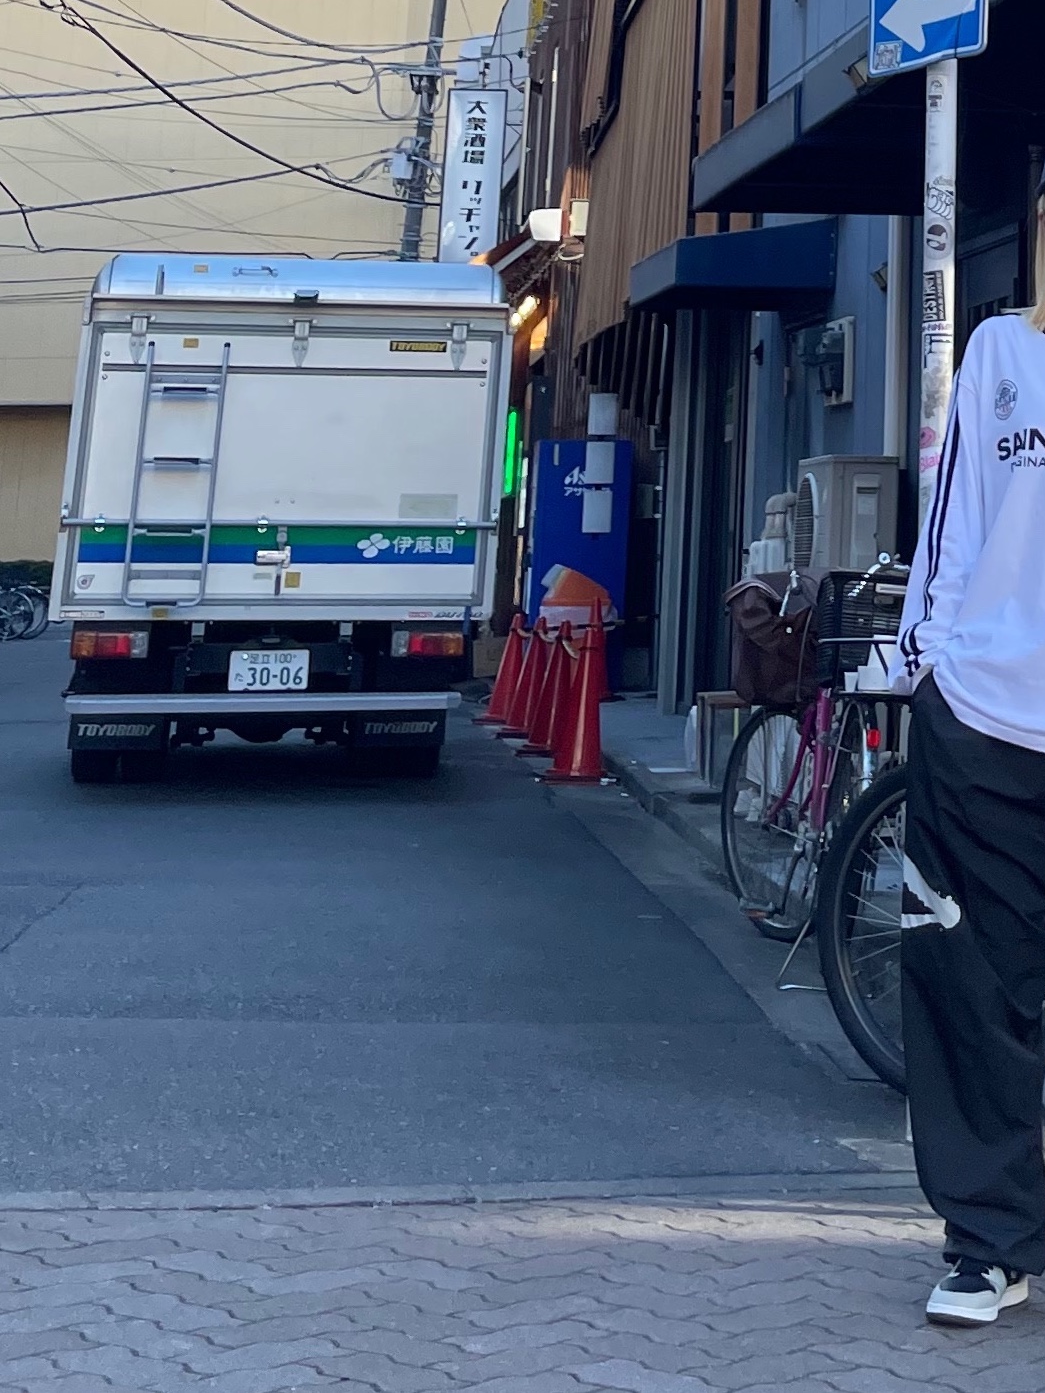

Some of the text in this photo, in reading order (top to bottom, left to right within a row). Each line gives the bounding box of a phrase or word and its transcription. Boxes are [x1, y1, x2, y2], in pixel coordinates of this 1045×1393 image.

[392, 535, 454, 555] 伊藤園
[274, 653, 292, 664] 100
[246, 667, 303, 686] 30-06
